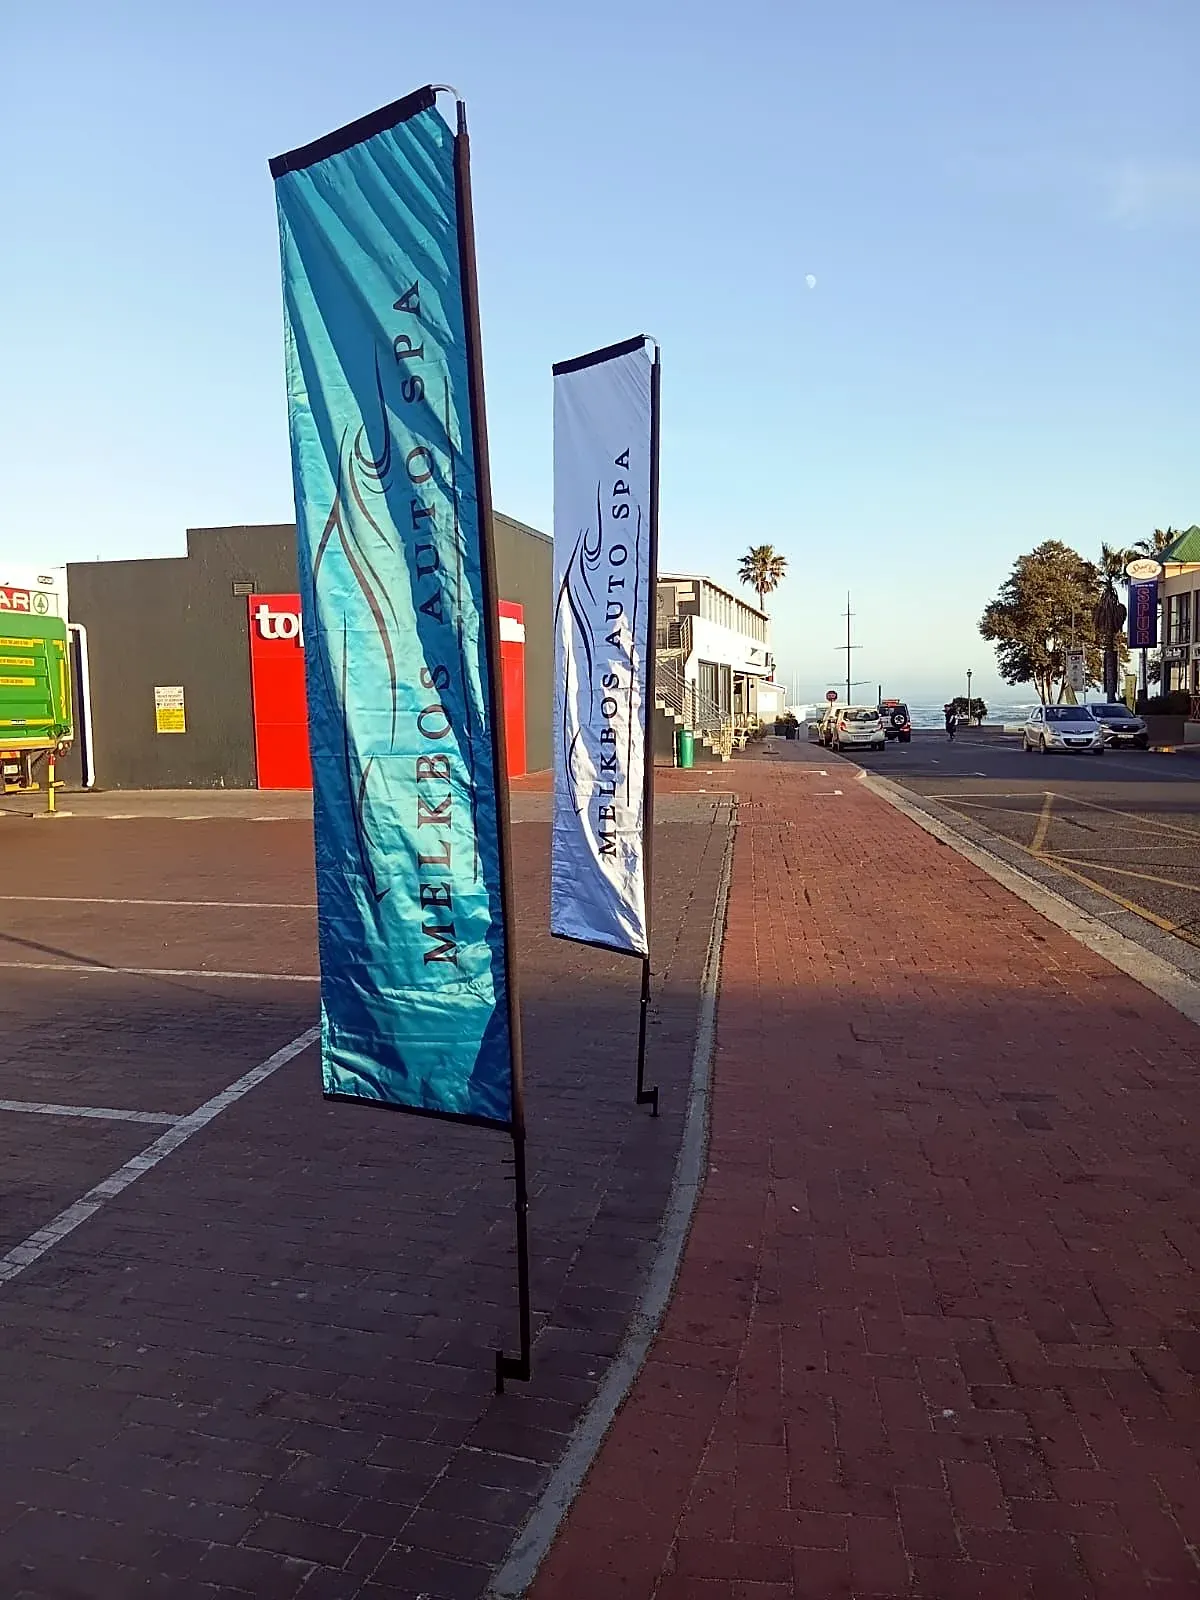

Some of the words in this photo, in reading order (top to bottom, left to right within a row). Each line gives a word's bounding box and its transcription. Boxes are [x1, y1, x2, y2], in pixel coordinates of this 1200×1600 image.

[392, 279, 425, 404] SPA
[405, 445, 443, 625] AUTO
[611, 447, 631, 519] SPA
[605, 543, 628, 650] AUTO
[1136, 587, 1150, 645] SPUR
[416, 666, 458, 967] MELKBOS
[598, 673, 620, 856] MELKBOS
